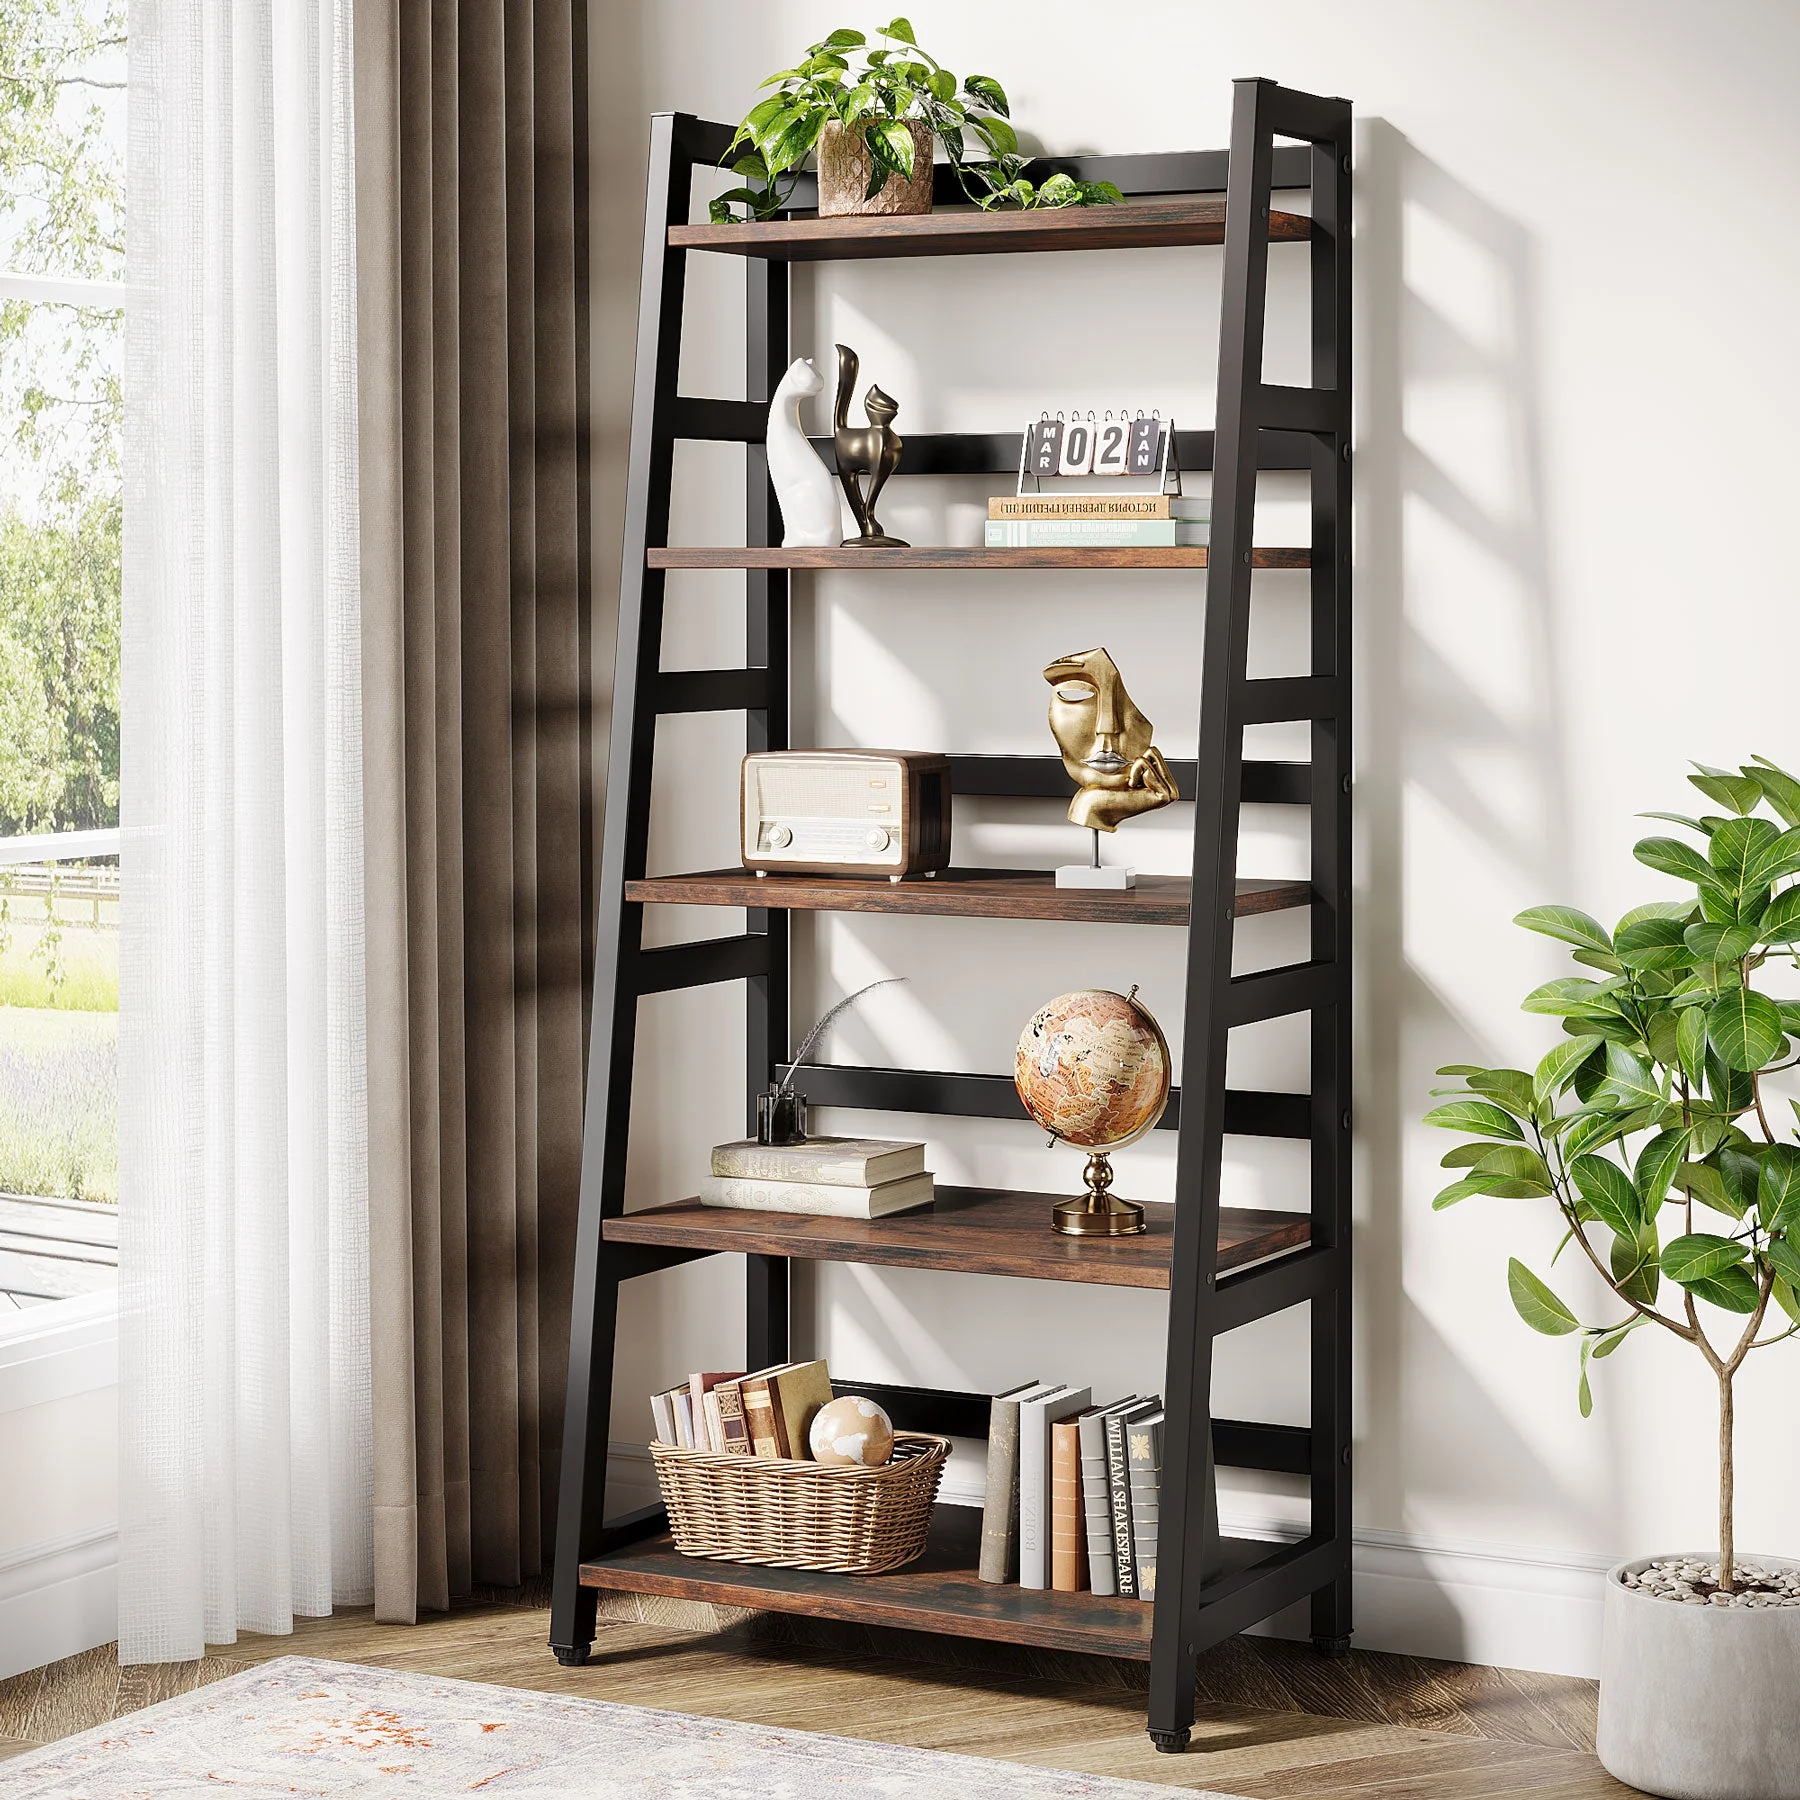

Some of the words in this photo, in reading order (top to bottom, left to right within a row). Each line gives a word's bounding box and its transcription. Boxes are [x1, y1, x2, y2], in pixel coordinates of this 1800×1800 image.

[1039, 427, 1057, 468] MAR
[1137, 425, 1150, 467] JAN
[1021, 502, 1060, 513] ГРЕЦИИ
[1062, 502, 1106, 514] ДРЕВНЕЙ
[1108, 502, 1157, 513] ИСТОРИЯ
[1107, 1417, 1126, 1487] WILLIAM
[1112, 1490, 1134, 1595] SHAKESPEARE
